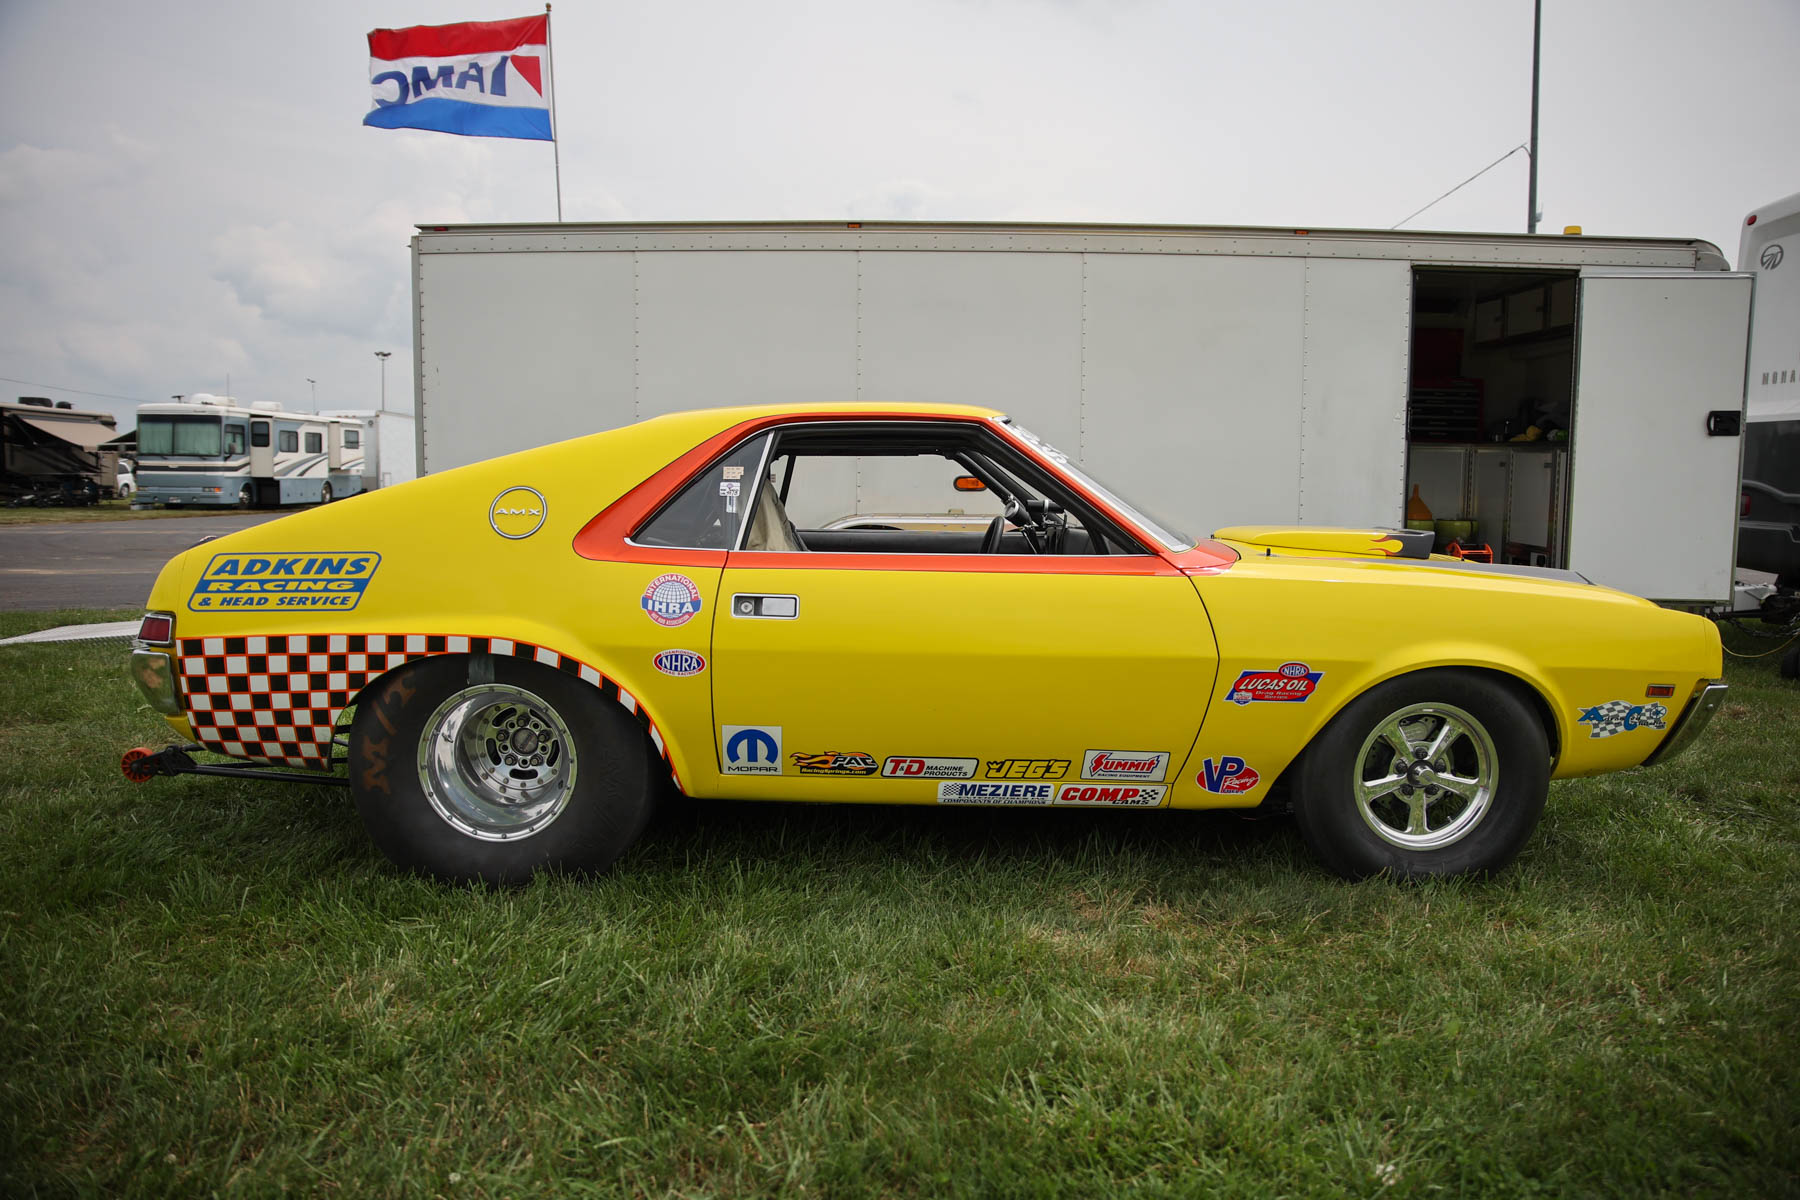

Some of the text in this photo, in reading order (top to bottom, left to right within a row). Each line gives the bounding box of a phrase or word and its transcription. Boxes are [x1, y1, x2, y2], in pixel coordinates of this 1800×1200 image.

[1762, 370, 1800, 385] MONA
[495, 508, 541, 516] AMX
[211, 557, 371, 576] ADKINS
[207, 581, 355, 591] RACING
[646, 574, 699, 599] INTERNATIONAL
[198, 596, 352, 607] & HEAD SERVICE
[647, 600, 694, 613] IHRA
[662, 655, 698, 671] NHRA
[1283, 665, 1305, 677] NHRA
[1238, 678, 1309, 691] LUCAS OIL
[830, 755, 877, 768] PAC
[801, 767, 867, 775] RacingSprings.com
[1203, 756, 1245, 793] VP
[959, 783, 1051, 797] MEZIERE
[1060, 787, 1140, 801] COMP
